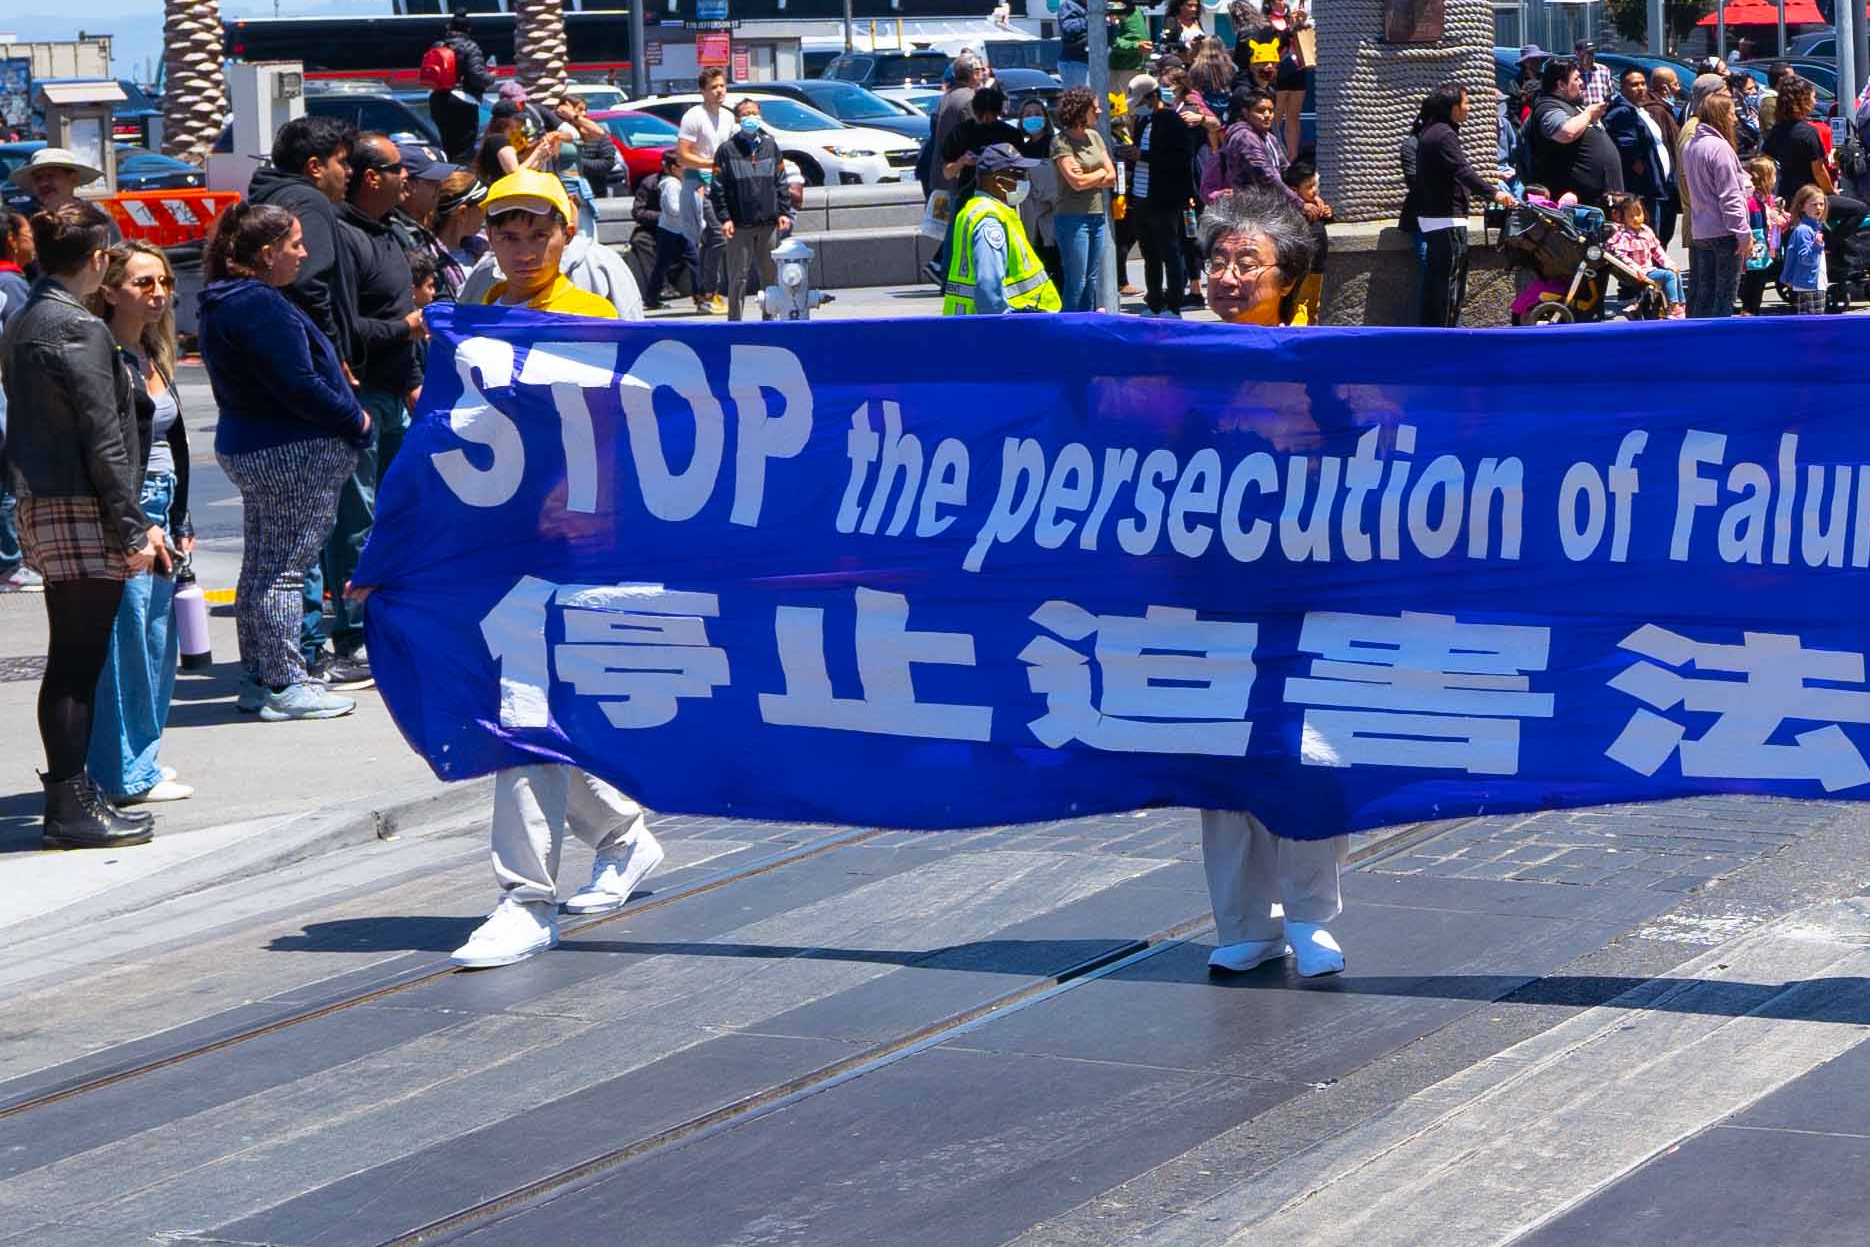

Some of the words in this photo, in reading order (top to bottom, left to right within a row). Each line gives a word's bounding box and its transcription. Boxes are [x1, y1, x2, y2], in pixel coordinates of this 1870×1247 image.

[430, 335, 814, 528] STOP
[836, 400, 970, 538] the
[962, 424, 1524, 573] persecution
[1558, 429, 1648, 563] of
